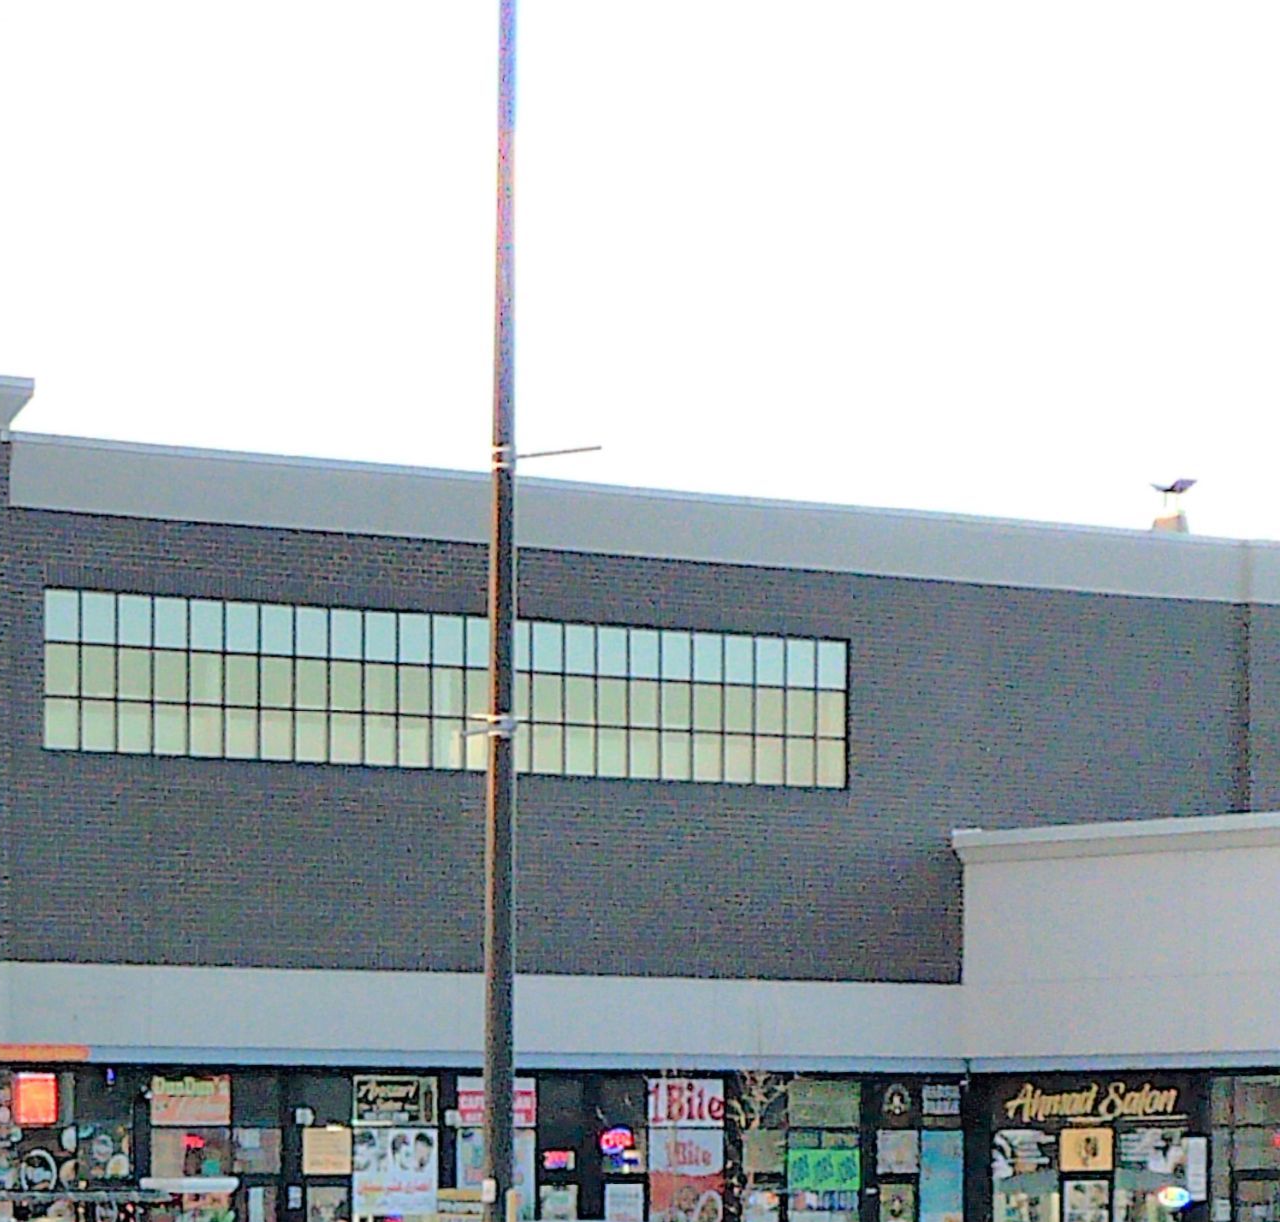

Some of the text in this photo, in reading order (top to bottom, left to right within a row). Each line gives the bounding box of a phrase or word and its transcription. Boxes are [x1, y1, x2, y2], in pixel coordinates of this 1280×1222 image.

[650, 1081, 725, 1124] 1 Bite
[1099, 1081, 1178, 1117] Salon
